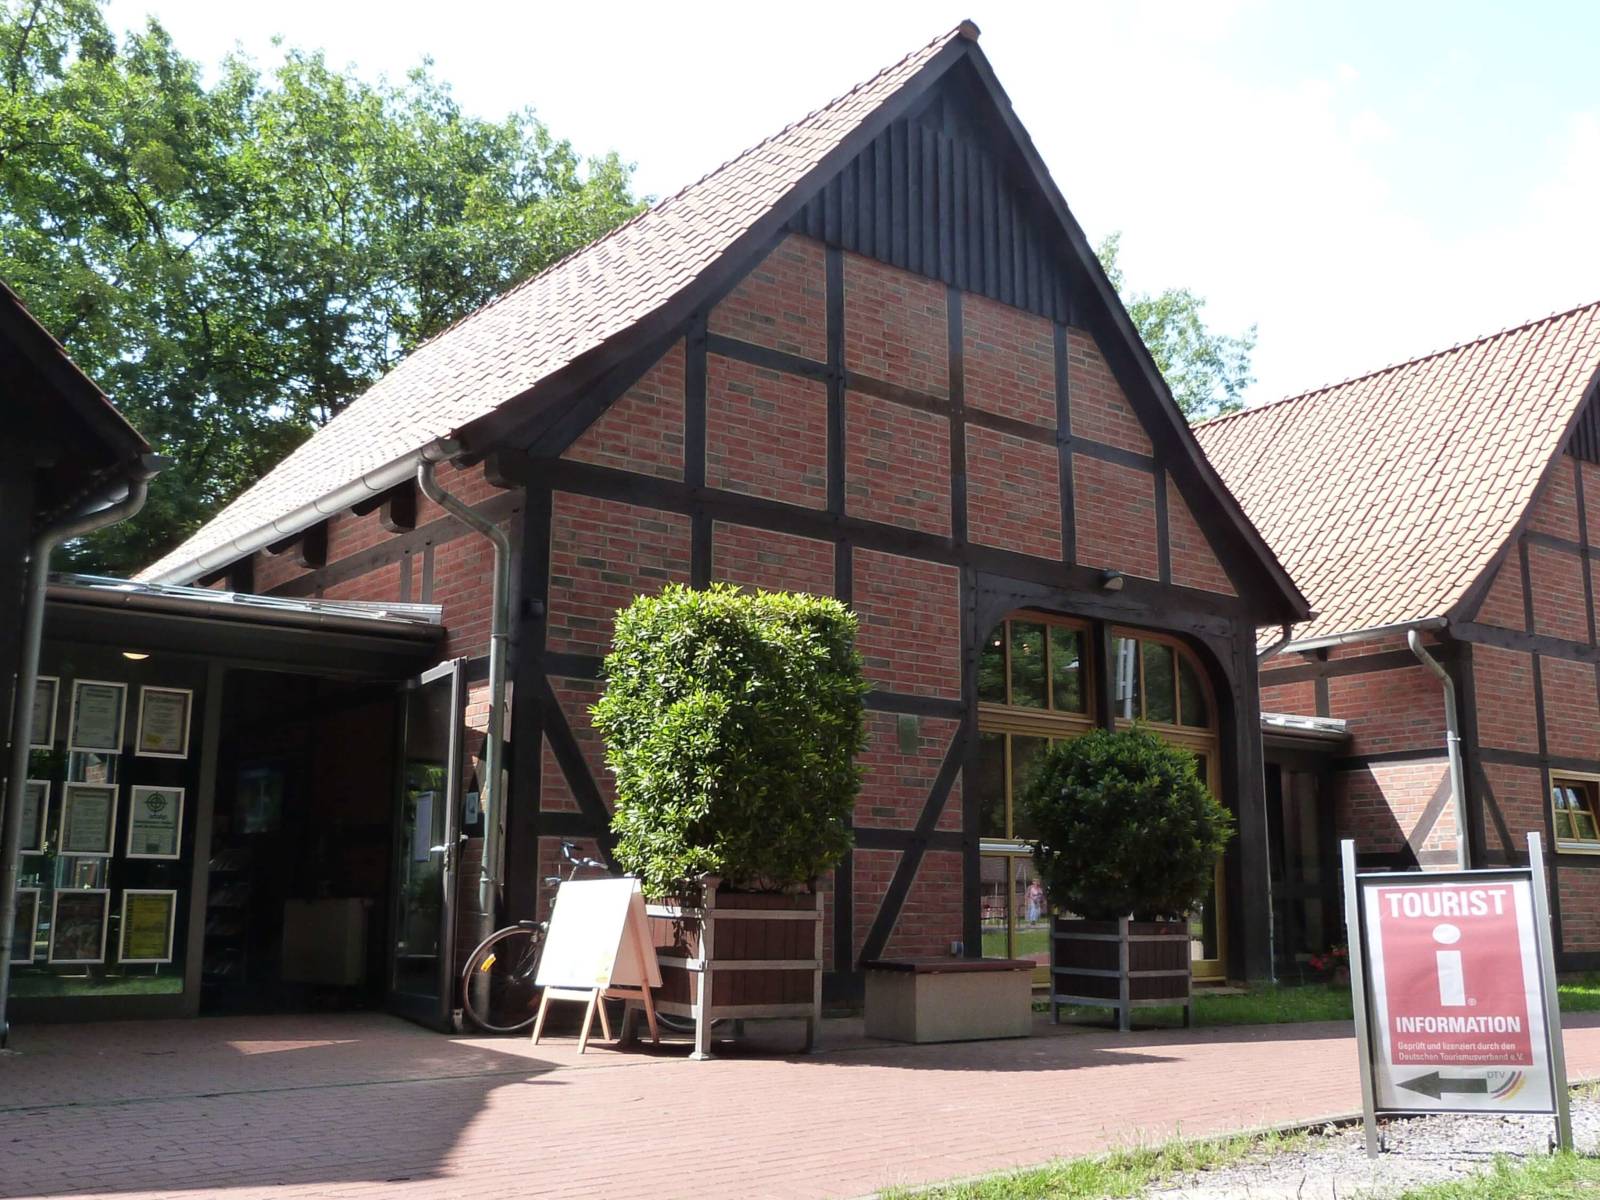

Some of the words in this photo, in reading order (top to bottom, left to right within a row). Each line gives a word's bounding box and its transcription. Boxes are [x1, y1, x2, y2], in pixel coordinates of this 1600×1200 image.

[1385, 889, 1507, 918] TOURIST
[1396, 1016, 1521, 1034] INFORMATION
[1397, 1041, 1426, 1051] Geprüft
[1427, 1042, 1441, 1050] und
[1442, 1042, 1476, 1050] lizenziert
[1478, 1042, 1499, 1050] durch
[1501, 1042, 1516, 1050] den
[1398, 1052, 1439, 1061] Deutschen
[1440, 1052, 1508, 1061] Tourismusverband
[1487, 1071, 1506, 1079] DTV
